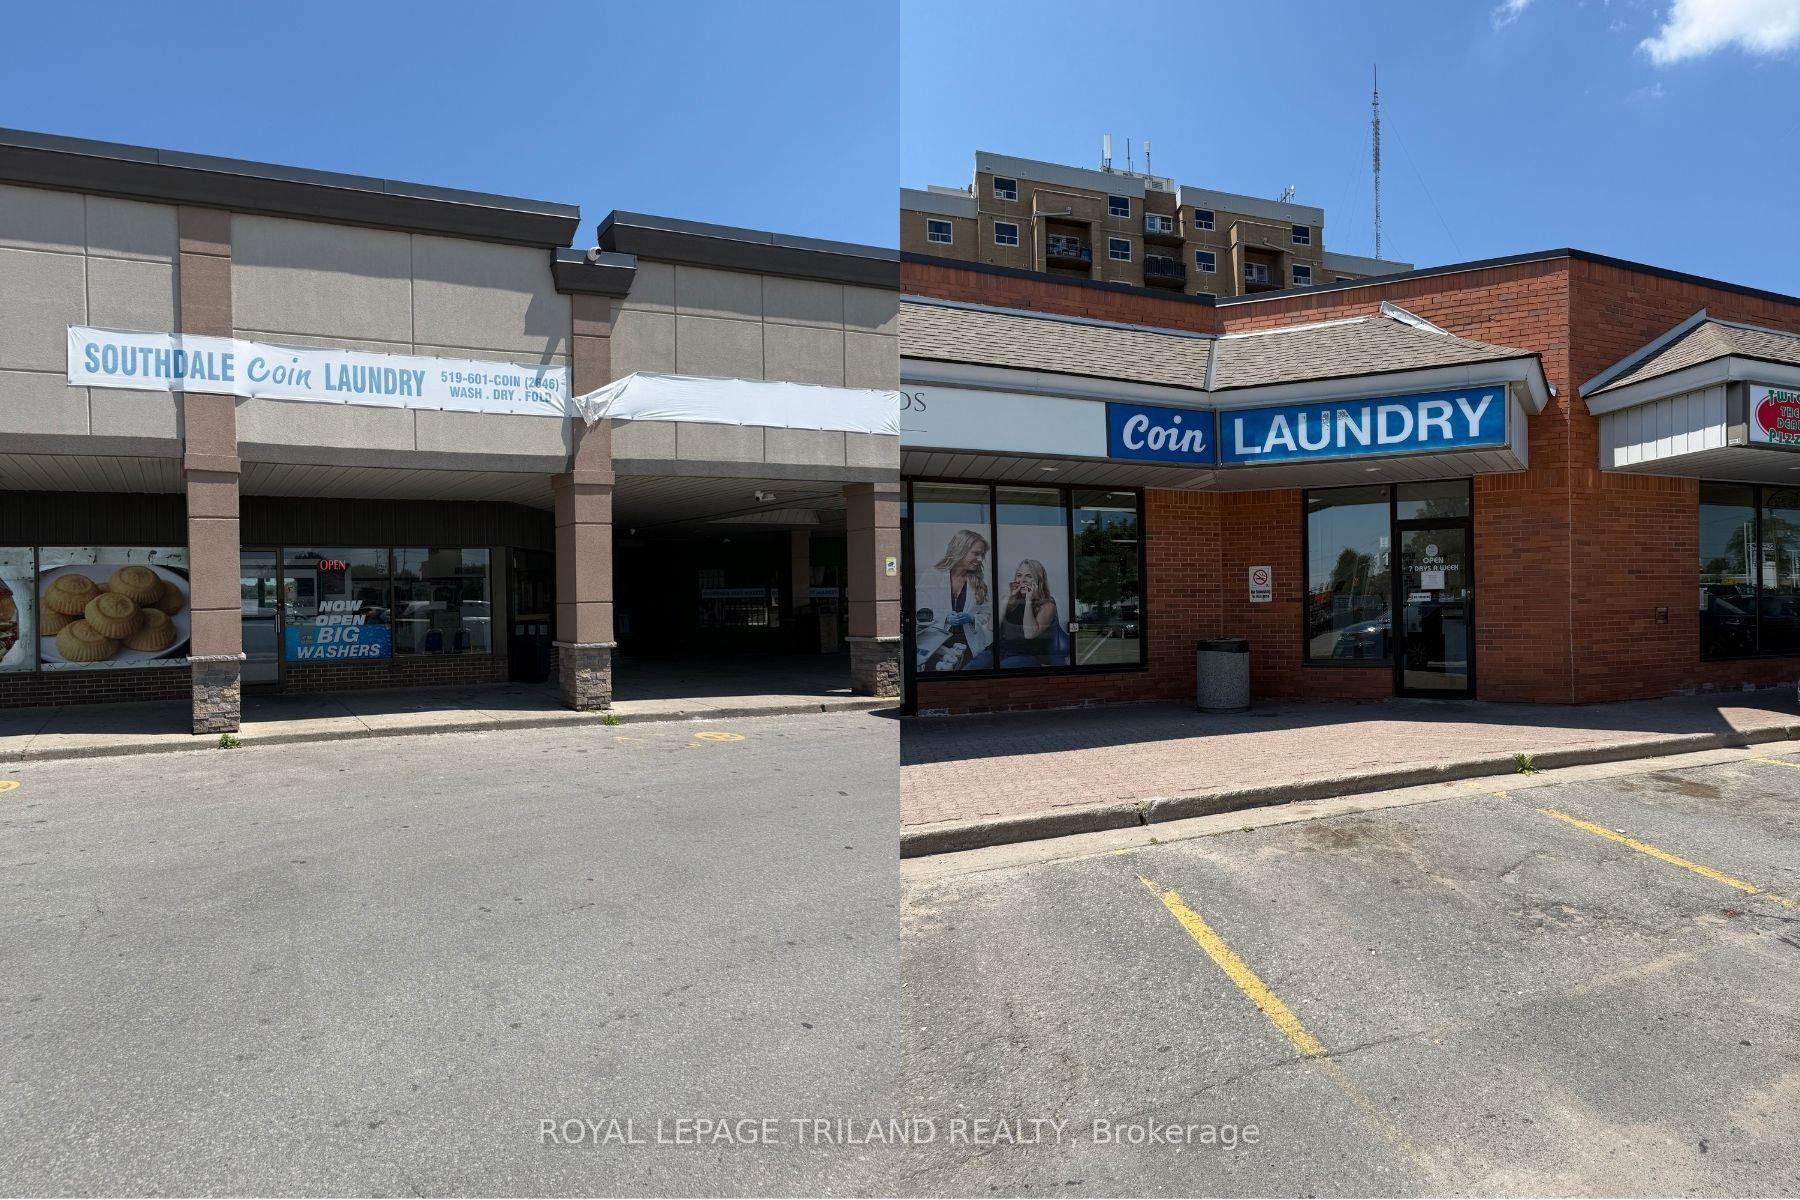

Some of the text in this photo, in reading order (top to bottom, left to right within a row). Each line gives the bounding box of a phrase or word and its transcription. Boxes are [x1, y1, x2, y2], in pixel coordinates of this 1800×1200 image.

[84, 342, 426, 397] SOUTHDALE Coin LAUNDRY
[440, 371, 559, 392] 519-601-COIN (2646)
[449, 386, 482, 399] WASH
[493, 389, 514, 401] DRY
[525, 391, 552, 403] FOLD
[1122, 414, 1206, 453] Coin
[1234, 395, 1494, 455] LAUNDRY
[320, 559, 346, 571] OPEN
[1422, 556, 1444, 564] OPEN
[318, 600, 363, 612] NOW
[315, 614, 367, 626] OPEN
[317, 626, 360, 644] BIG
[297, 643, 381, 659] WASHERS
